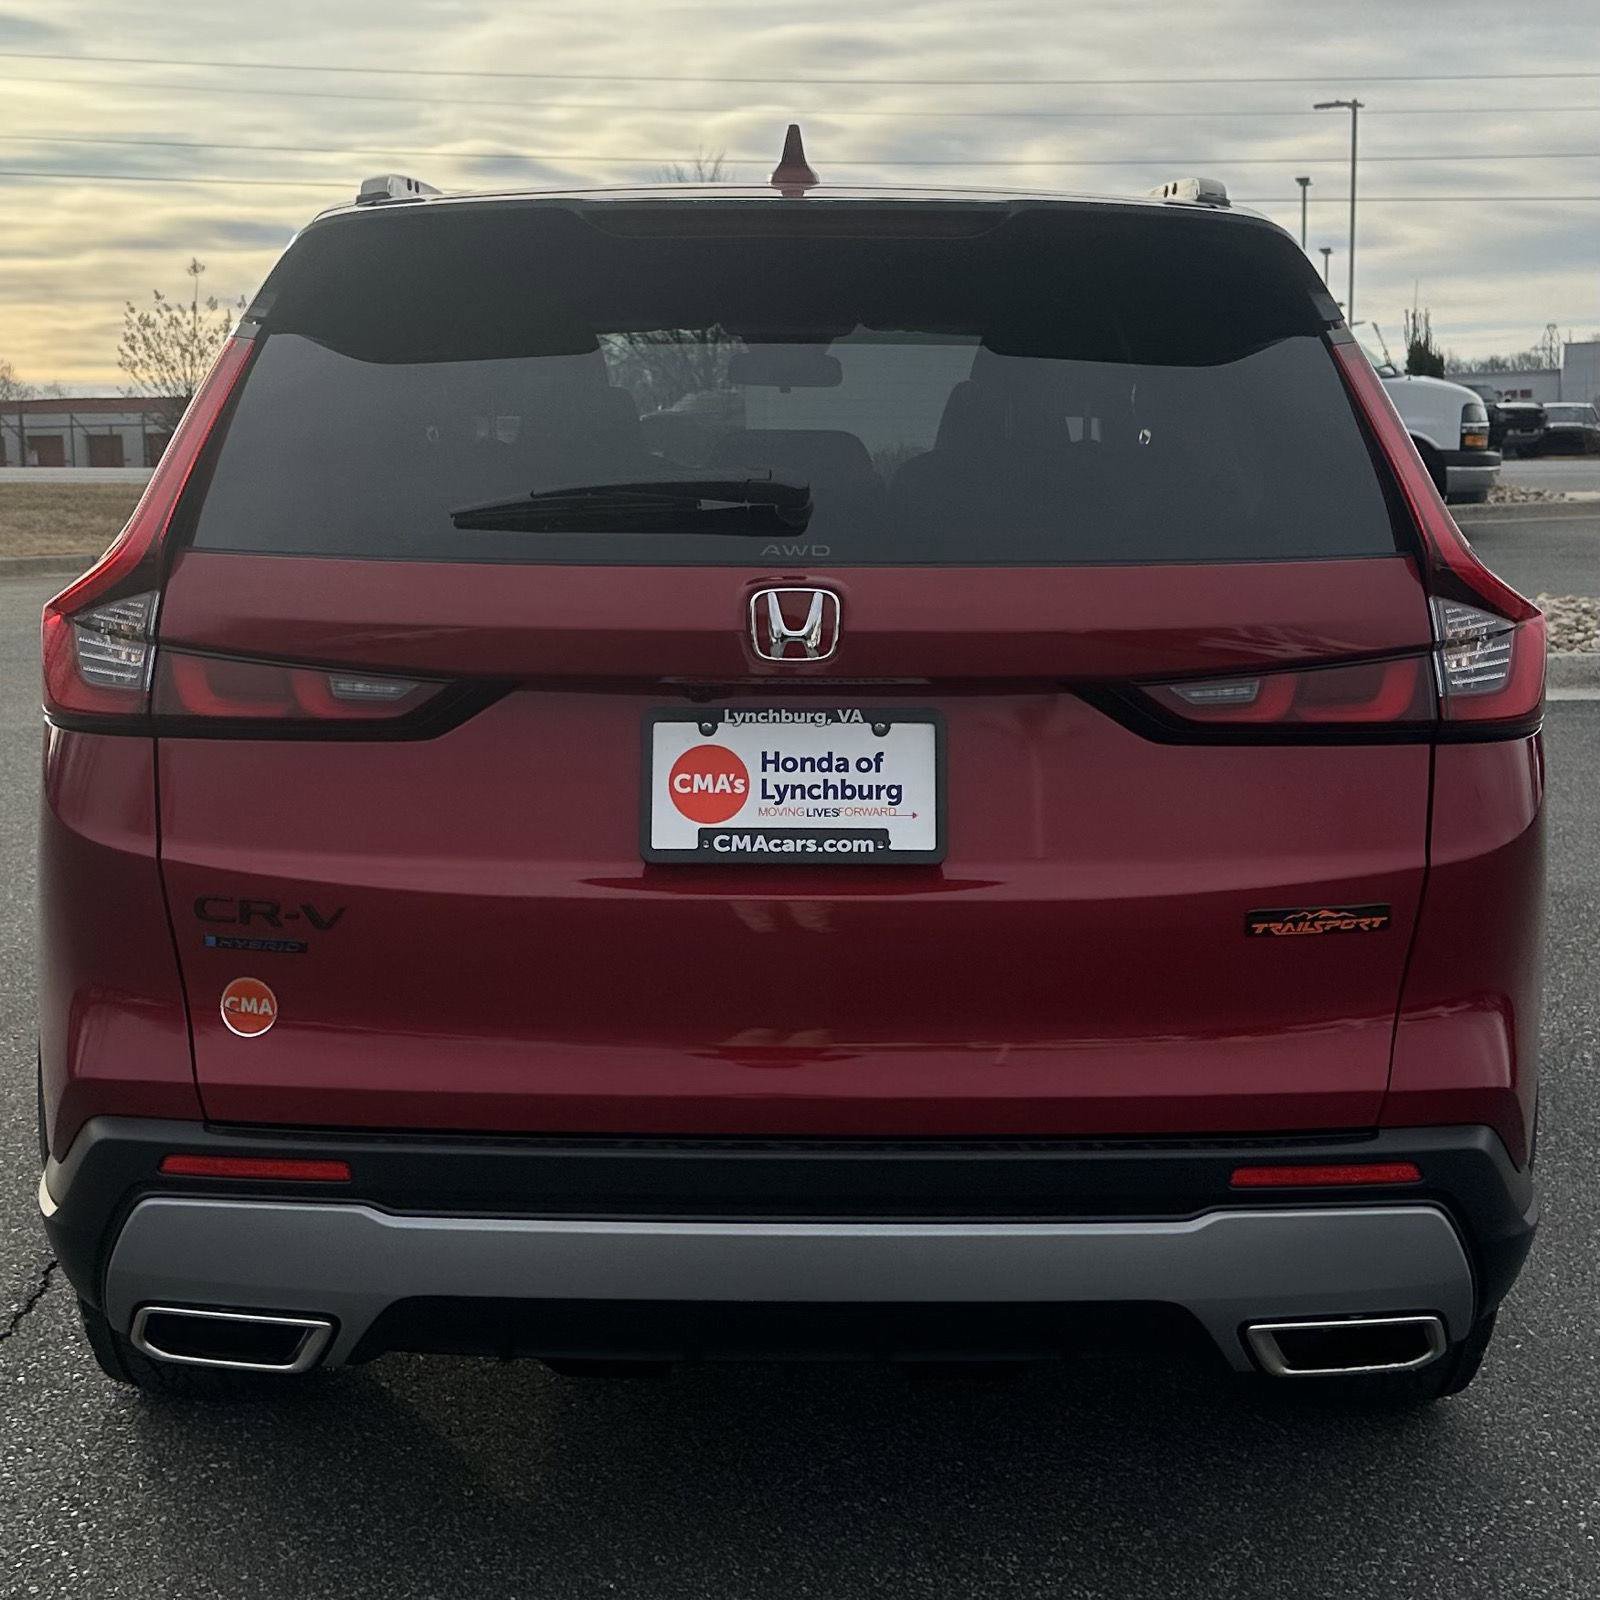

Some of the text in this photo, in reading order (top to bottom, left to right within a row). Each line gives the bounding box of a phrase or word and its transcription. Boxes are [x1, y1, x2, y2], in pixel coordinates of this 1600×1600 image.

[760, 544, 831, 557] AWD
[724, 709, 864, 727] Lynchburg, VA
[761, 751, 885, 774] Honda of
[673, 773, 747, 795] CMA's
[761, 779, 903, 806] Lynchburg
[712, 834, 875, 853] CMAcars.com
[193, 896, 347, 931] CR-V
[1251, 917, 1389, 935] TRAILSPORT
[224, 996, 274, 1016] CMA
